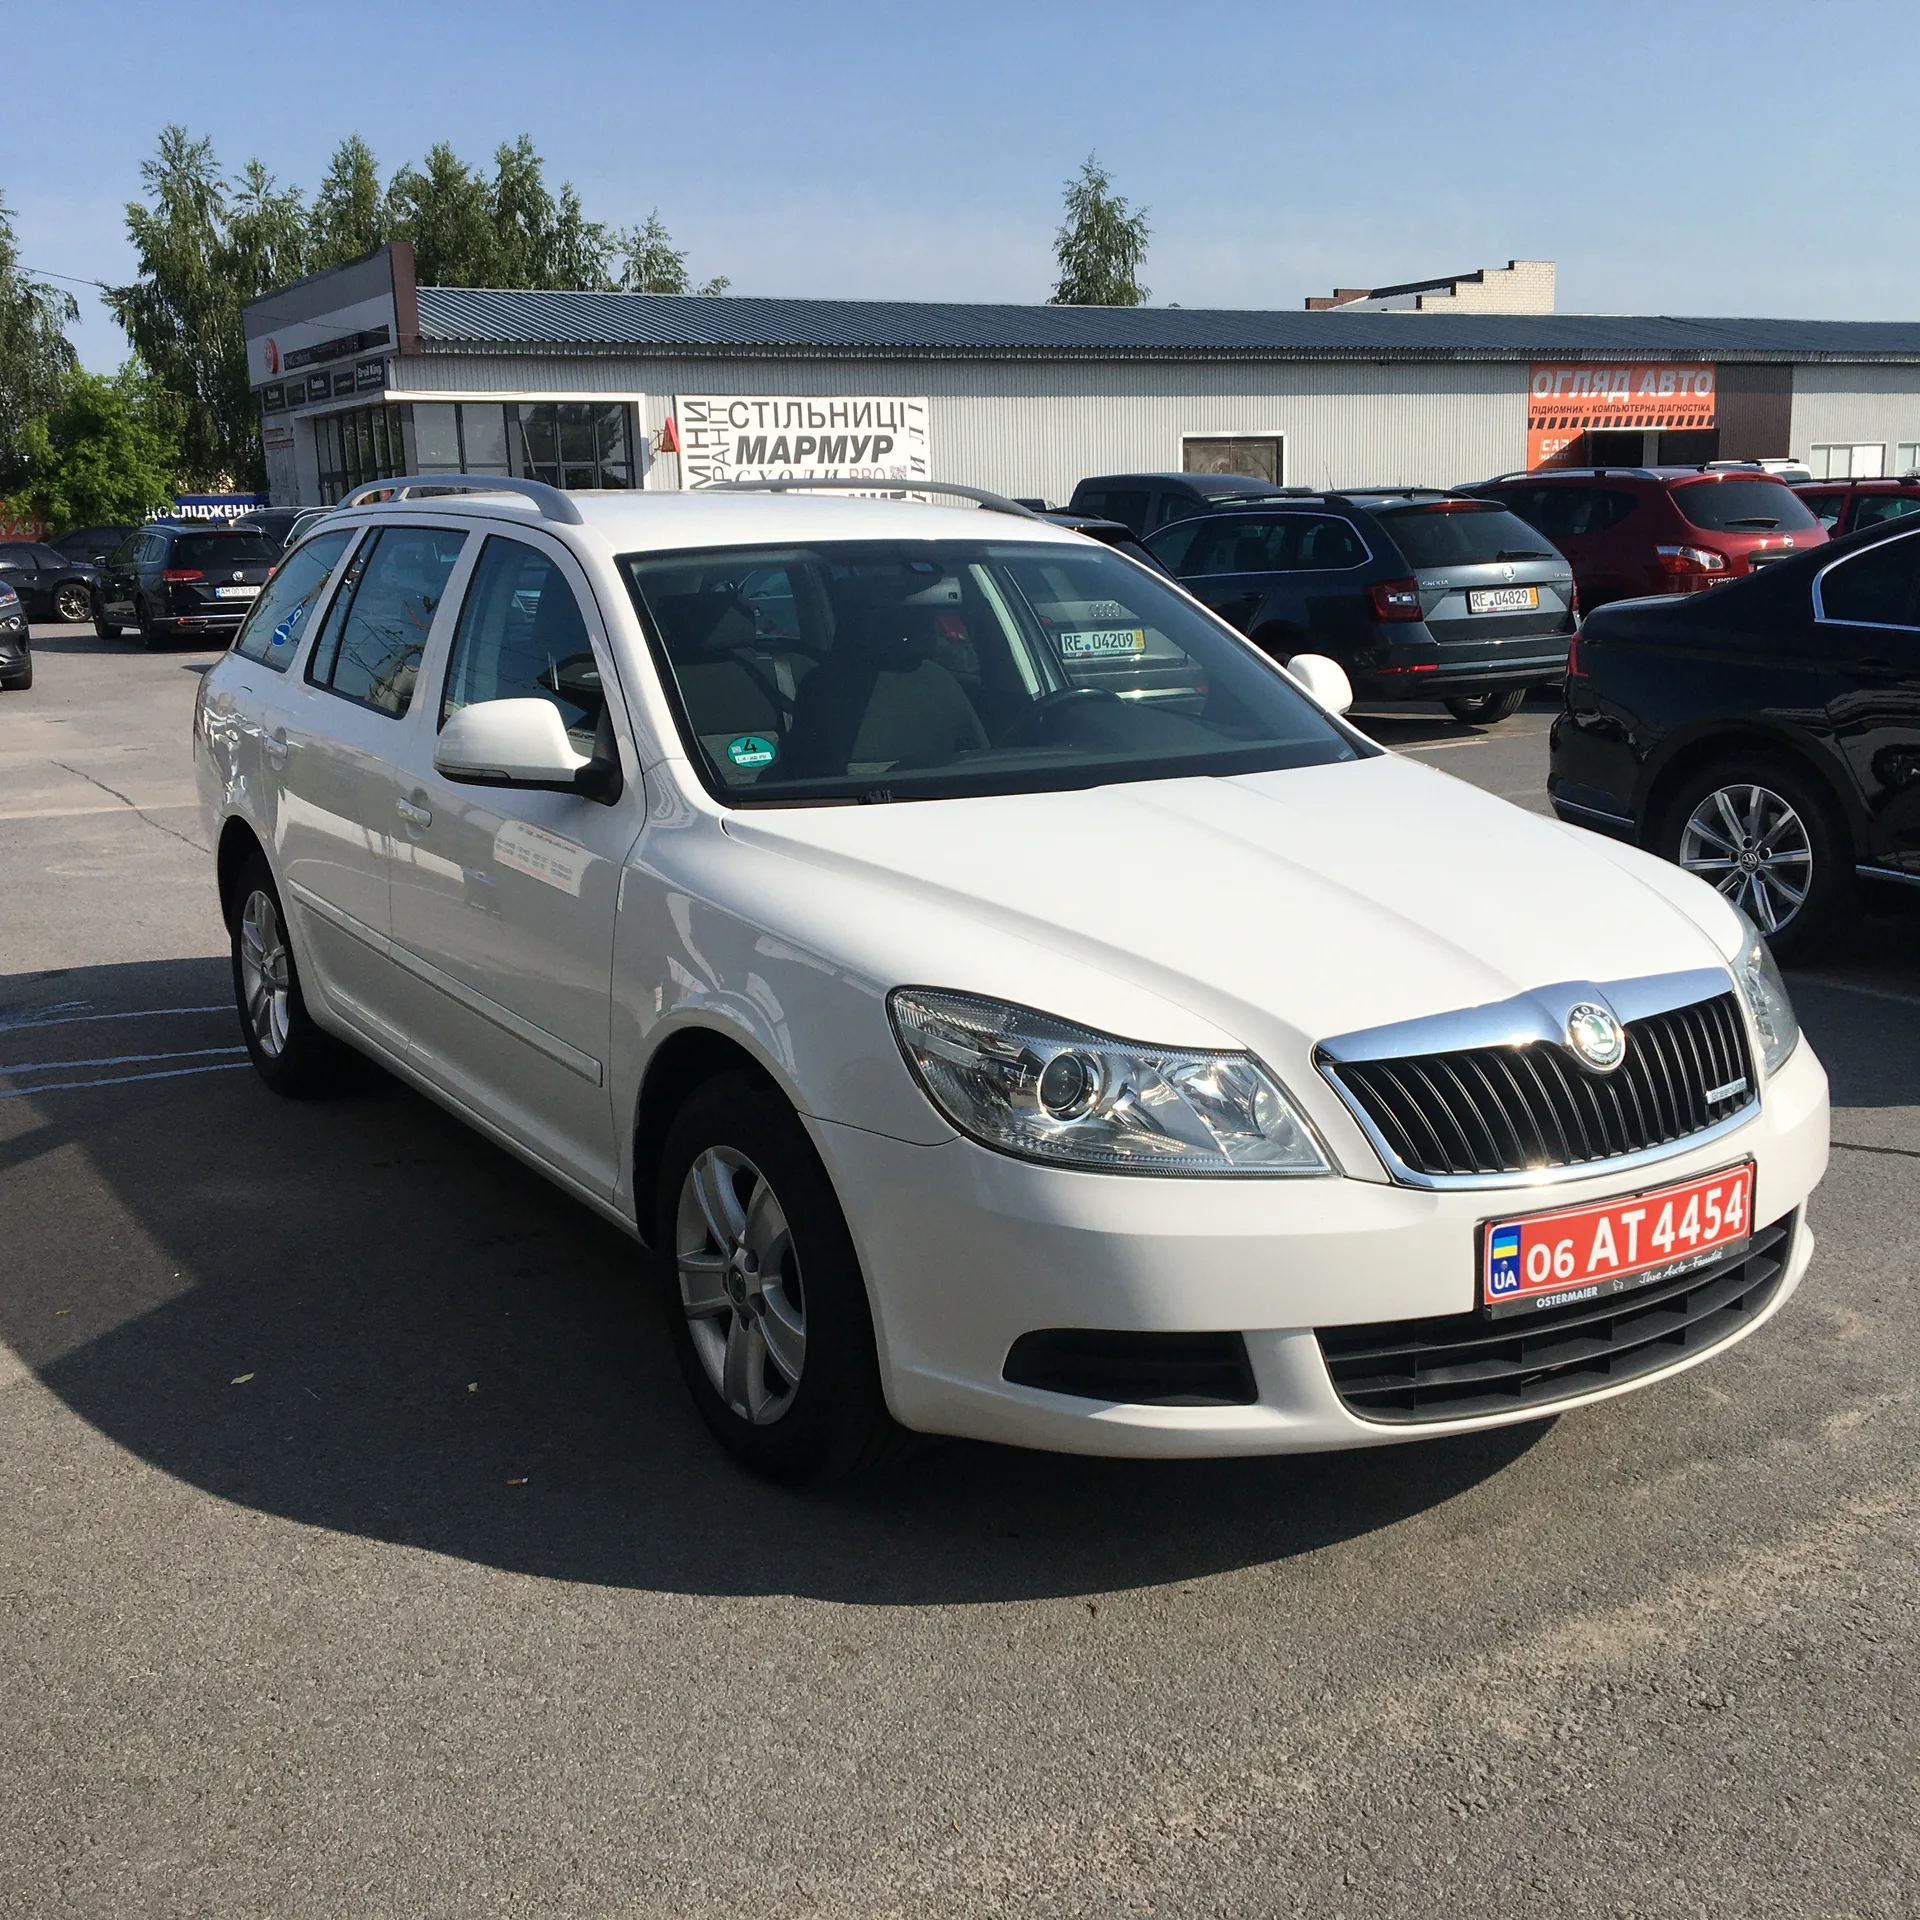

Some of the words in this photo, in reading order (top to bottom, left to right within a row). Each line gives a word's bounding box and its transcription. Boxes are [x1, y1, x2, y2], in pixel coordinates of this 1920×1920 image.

[1532, 370, 1632, 403] ОГЛЯД
[1637, 370, 1713, 398] АВТО
[728, 401, 906, 434] СТІЛЬНИЦІ
[684, 401, 712, 489] МІНИ
[708, 401, 732, 483] РАНІТ
[735, 435, 894, 465] МАРМУР
[11, 521, 57, 535] АВТ
[1472, 592, 1489, 607] RE
[1494, 589, 1528, 605] 04829
[1064, 635, 1084, 651] RE
[1092, 632, 1133, 649] 04209
[743, 738, 758, 752] 4
[1526, 1239, 1575, 1283] 06
[1586, 1208, 1646, 1272] AT
[1651, 1179, 1743, 1253] 4454
[1494, 1271, 1518, 1290] UA
[1535, 1286, 1598, 1309] OSTERMAIER
